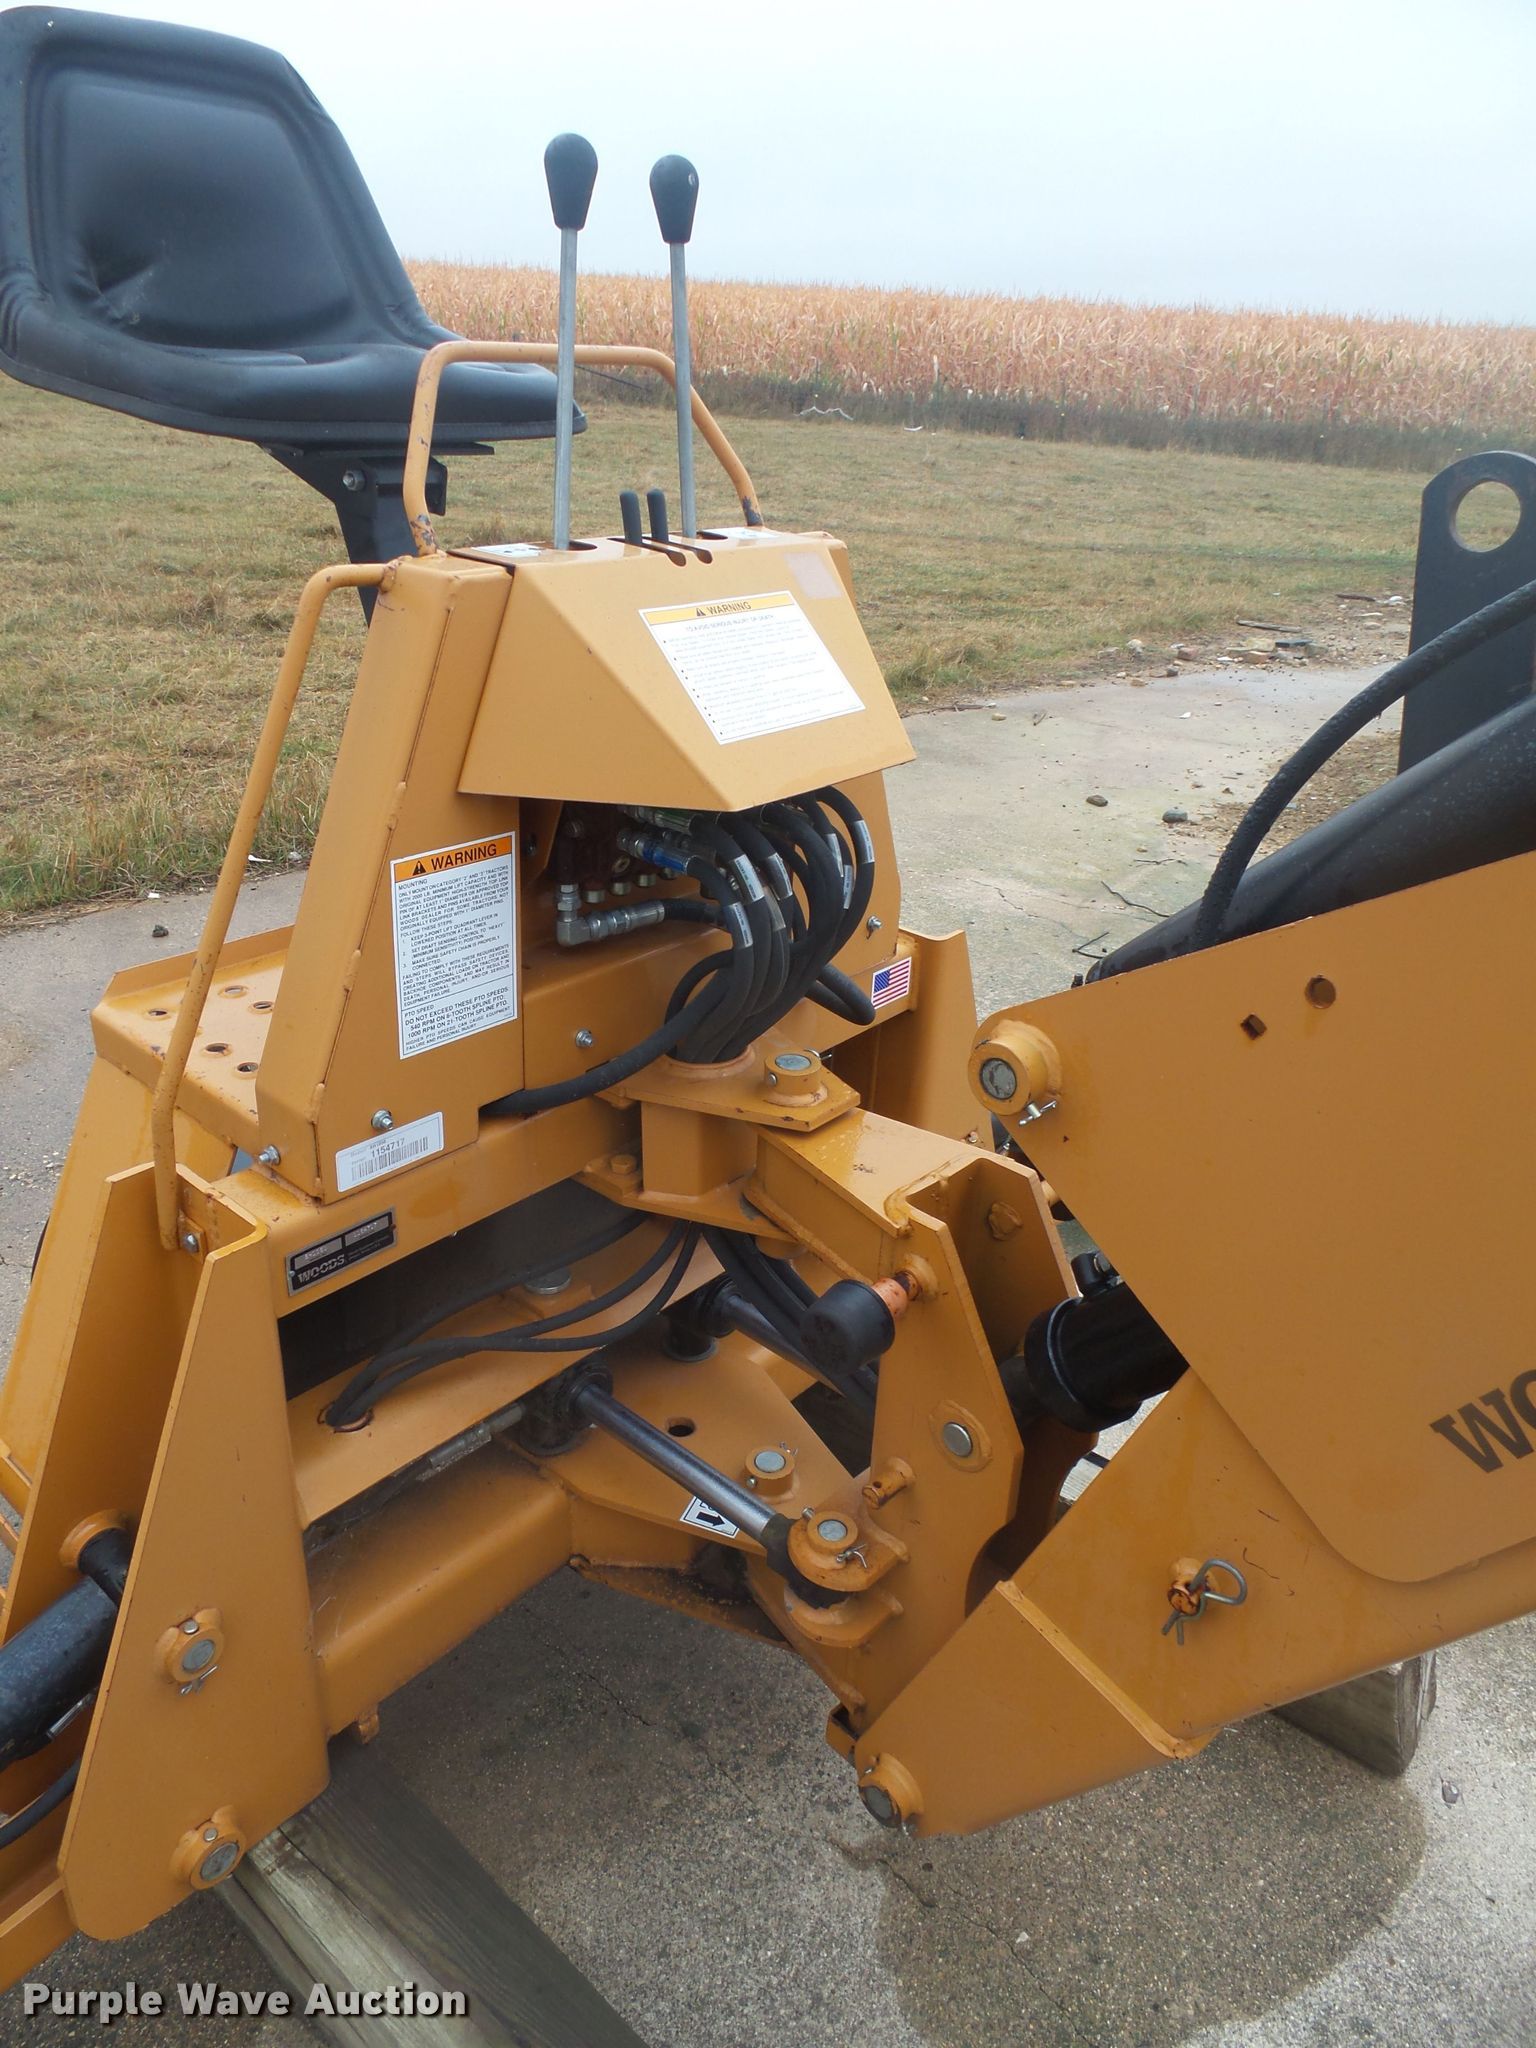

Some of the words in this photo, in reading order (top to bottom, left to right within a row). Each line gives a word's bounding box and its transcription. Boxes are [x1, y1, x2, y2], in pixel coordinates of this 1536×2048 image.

[706, 601, 752, 615] WARNING
[431, 843, 496, 871] WARNING
[485, 864, 507, 874] TRACTORS
[398, 878, 427, 890] MOUNTING
[432, 885, 452, 894] MINIMUM
[465, 876, 485, 885] CAPACITY
[399, 899, 421, 909] ORIGINAL
[423, 891, 449, 902] EQUIPMENT
[411, 906, 436, 916] BRACKETS
[459, 893, 482, 903] AVAILABLE
[423, 900, 437, 908] LEAST
[444, 892, 467, 902] DIAMETER
[476, 883, 498, 893] APPROVED
[400, 919, 427, 931] ORIGINALLY
[429, 912, 452, 923] EQUIPPED
[471, 901, 492, 911] DIAMETER
[421, 910, 441, 919] DEALER
[454, 918, 477, 929] QUADRANT
[478, 913, 492, 921] LEVER
[400, 928, 419, 937] FOLLOW
[411, 936, 434, 947] LOWERED
[435, 930, 455, 940] POSITION
[421, 942, 436, 950] DRAFT
[437, 936, 457, 945] SENSING
[458, 929, 478, 939] CONTROL
[412, 957, 424, 965] MAKE
[426, 953, 438, 961] SURE
[439, 948, 456, 956] SAFETY
[458, 943, 471, 951] CHAIN
[477, 934, 499, 945] PROPERLY
[428, 962, 447, 972] COMPLY
[461, 953, 475, 961] THESE
[476, 943, 508, 957] REQUIREMENTS
[403, 980, 426, 991] CREATING
[428, 971, 454, 983] ADDITIONAL
[455, 965, 470, 974] LOADS
[479, 956, 499, 966] TRACTOR
[415, 973, 431, 981] STEPS
[448, 961, 466, 971] BYPASS
[469, 955, 486, 964] SAFETY
[486, 960, 502, 969] RESULT
[423, 983, 448, 995] PERSONAL
[490, 963, 509, 973] SERIOUS
[404, 994, 430, 1007] EQUIPMENT
[416, 1003, 433, 1014] SPEED
[429, 1005, 452, 1017] EXCEED
[454, 998, 472, 1008] THESE
[472, 998, 491, 1009] SPLINE
[408, 1029, 420, 1038] 1000
[475, 1003, 494, 1015] SPLINE
[437, 1025, 455, 1034] SPEEDS
[406, 1041, 424, 1051] FAILURE
[436, 1028, 459, 1040] PERSONAL
[371, 1138, 405, 1157] 1154717
[298, 1254, 345, 1283] WOODS
